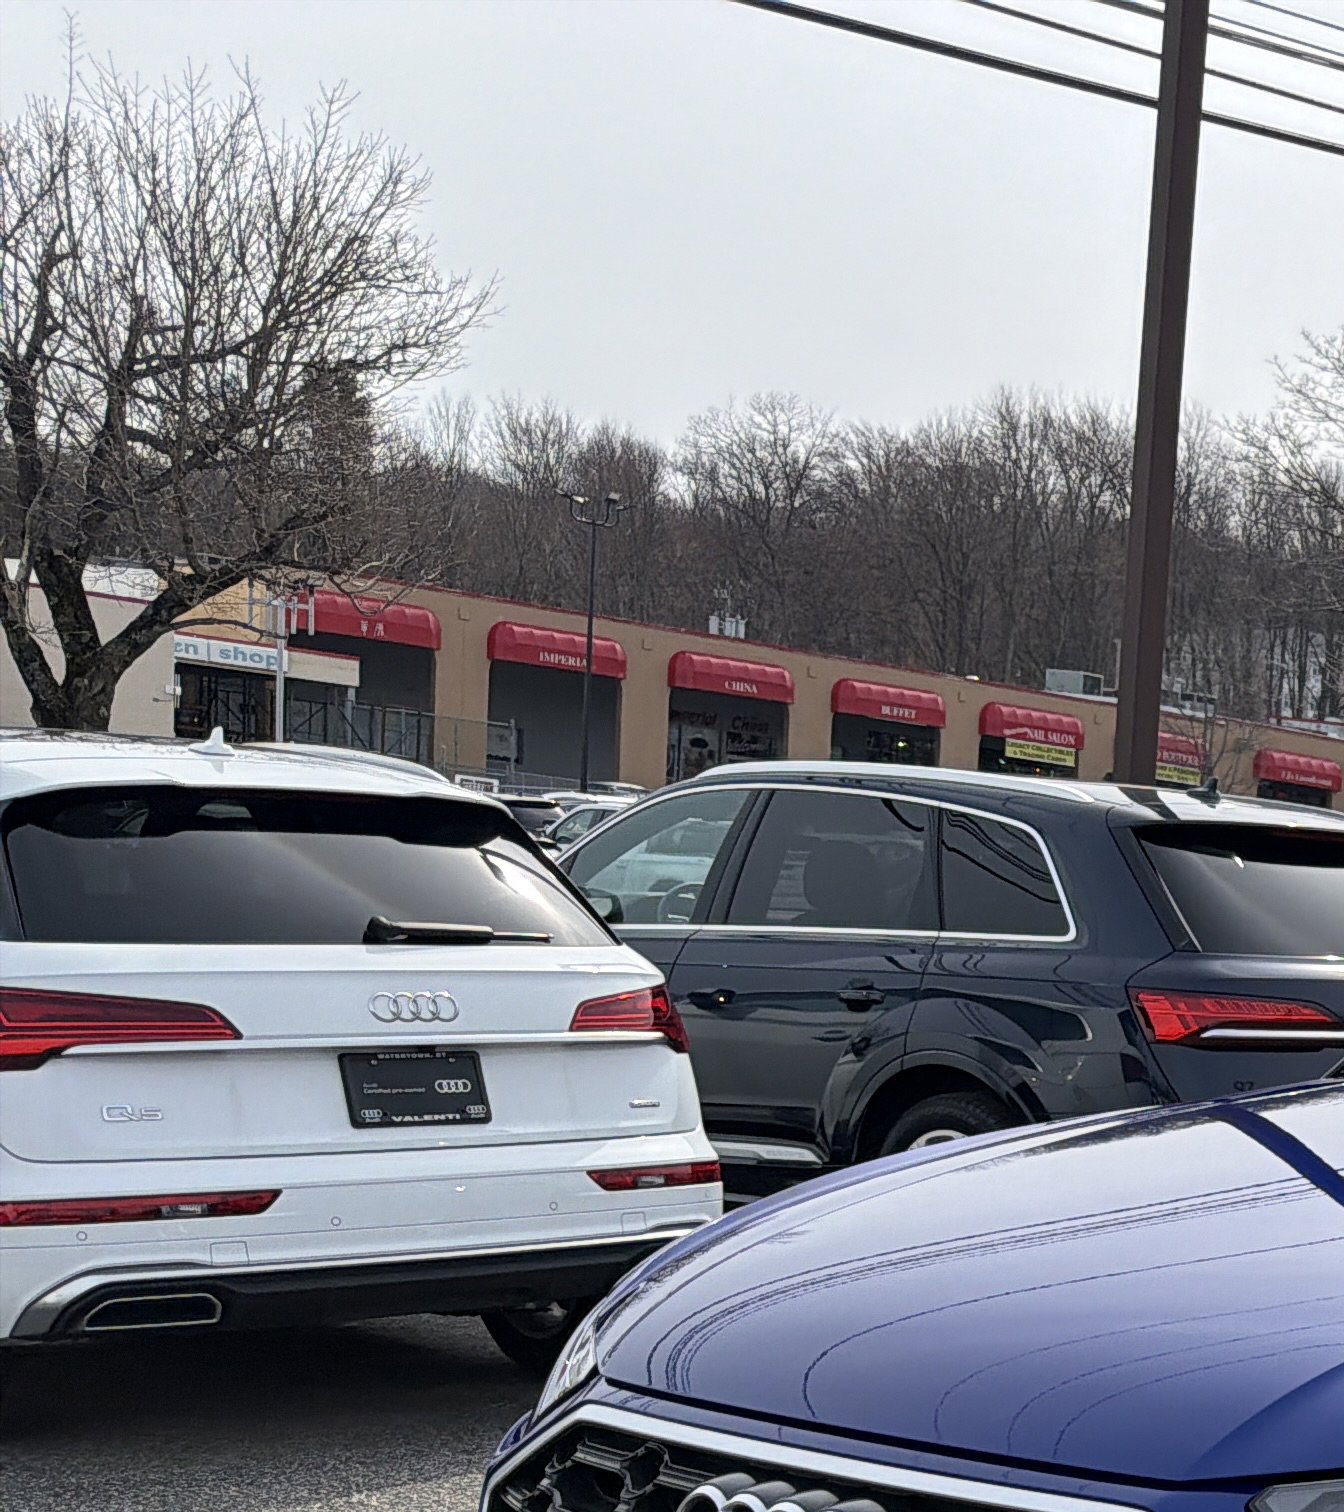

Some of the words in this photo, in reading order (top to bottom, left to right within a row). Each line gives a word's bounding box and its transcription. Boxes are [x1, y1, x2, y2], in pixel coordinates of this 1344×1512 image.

[539, 651, 595, 669] IMPERIA
[724, 680, 758, 694] CHINA
[880, 705, 917, 719] BUFFET
[1025, 728, 1046, 741] NAIL
[1047, 731, 1077, 745] SALON
[102, 1104, 163, 1122] Q5
[391, 1113, 461, 1122] VALENTI
